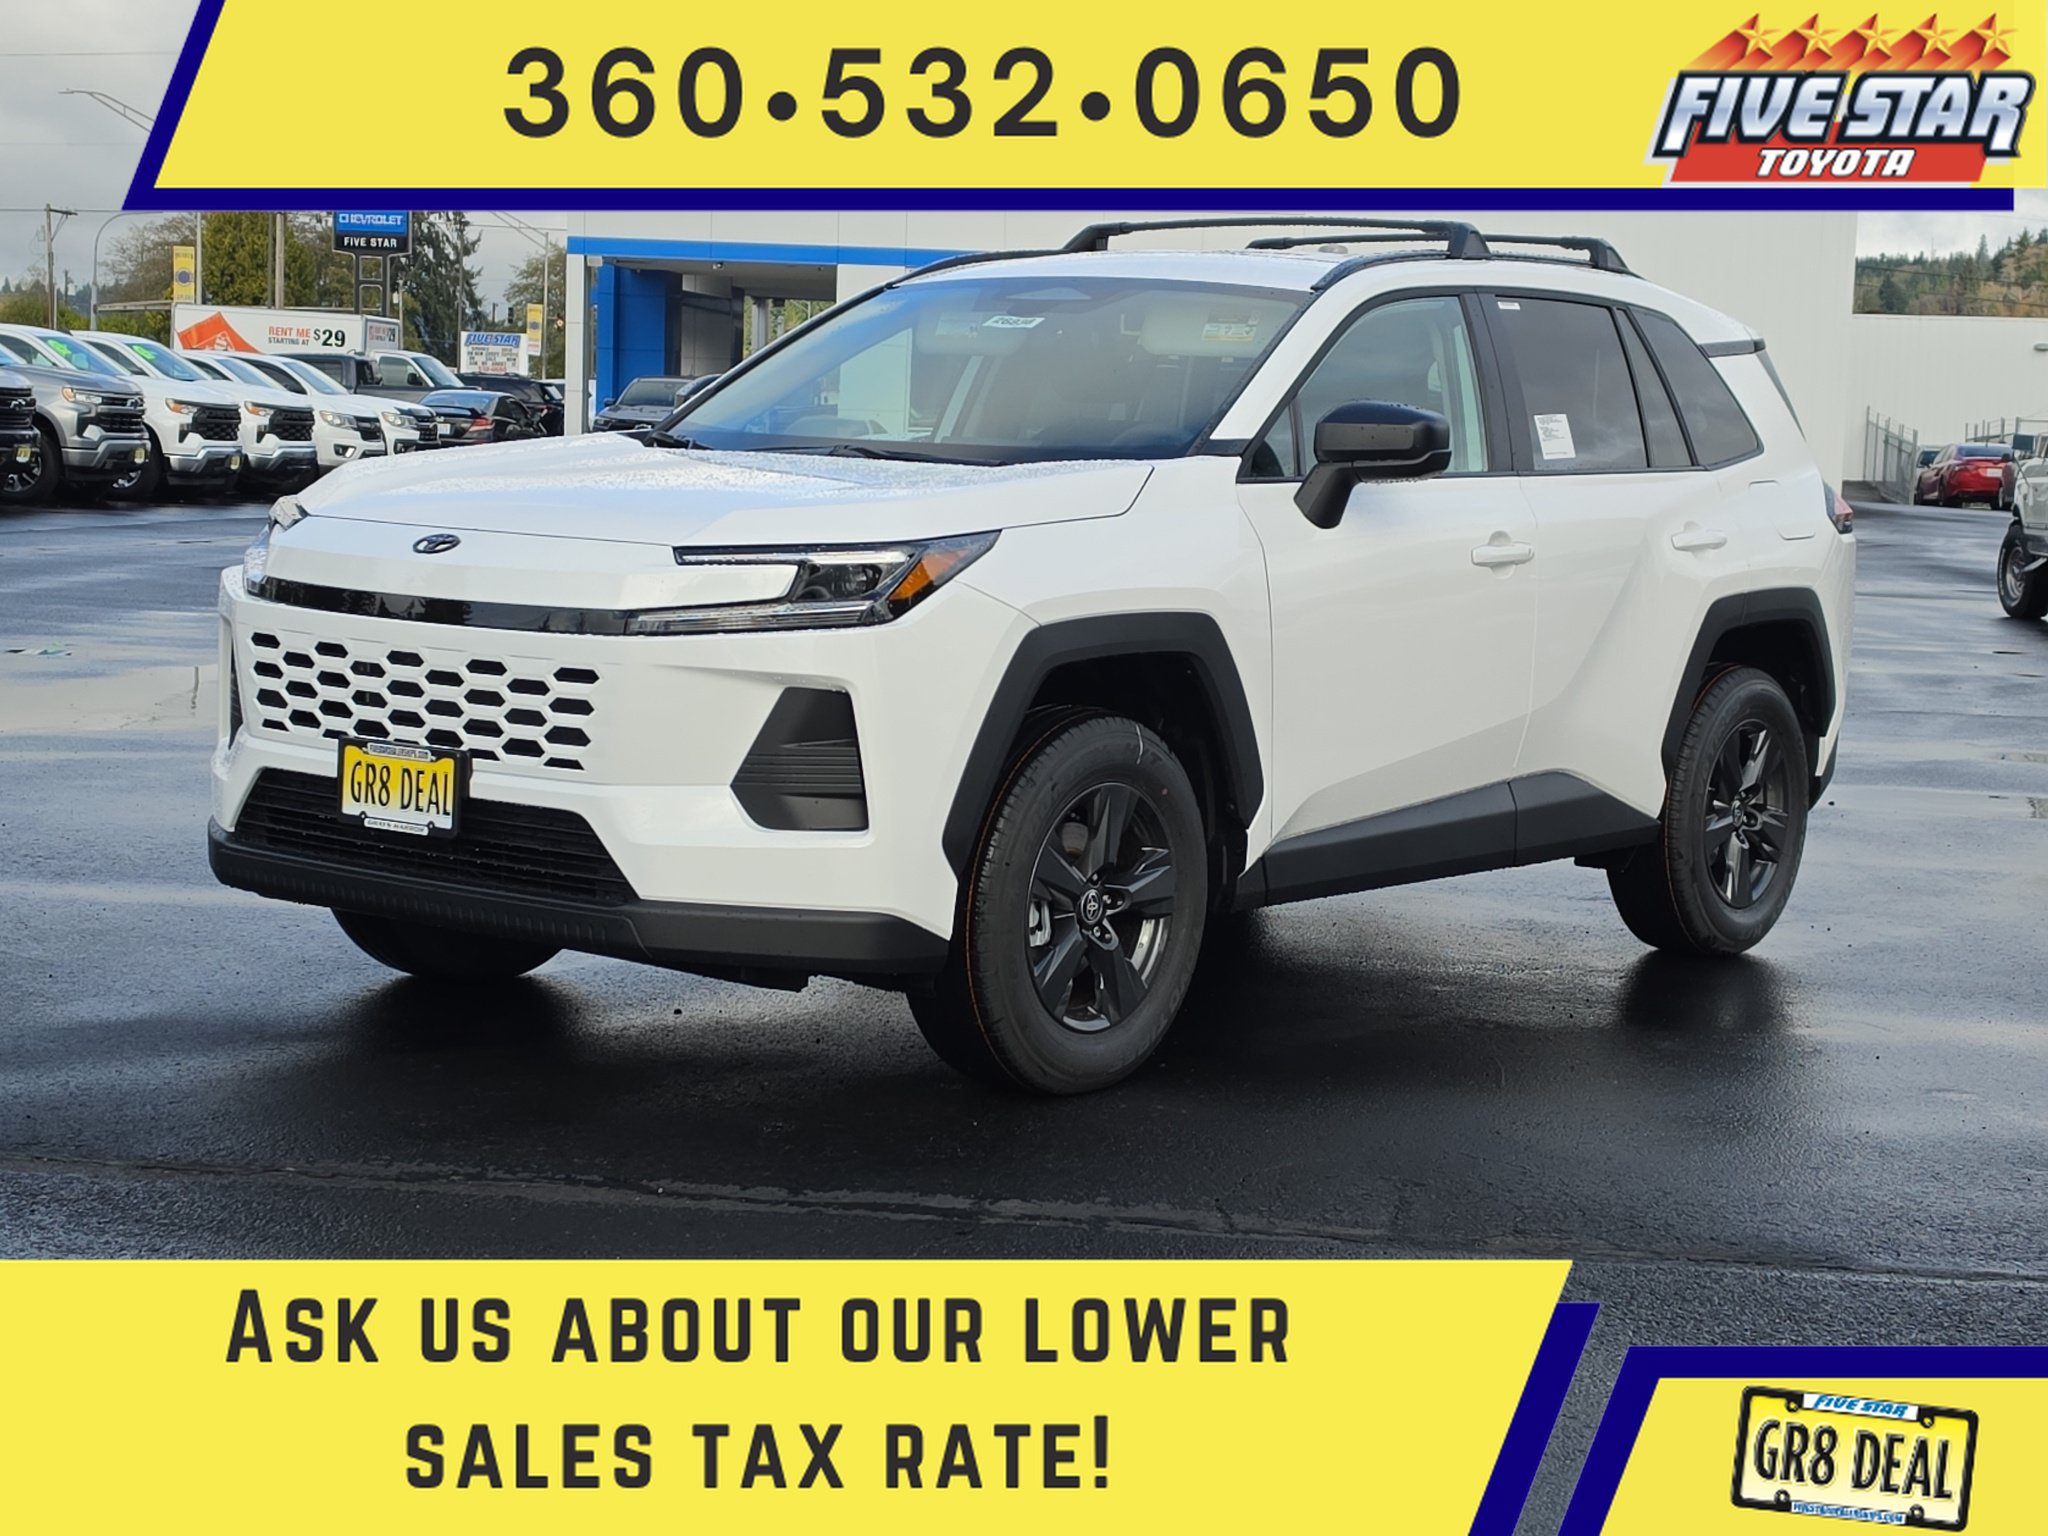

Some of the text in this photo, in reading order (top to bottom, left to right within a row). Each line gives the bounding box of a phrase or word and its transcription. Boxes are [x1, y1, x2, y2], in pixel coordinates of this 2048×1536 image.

[339, 213, 404, 226] CHEVROLET
[343, 236, 398, 248] FIVE STAR
[268, 326, 346, 348] RENT ME $29
[268, 337, 300, 345] STARTING
[464, 333, 493, 347] FIVE
[492, 334, 521, 348] STAR
[350, 760, 451, 816] GR8 DEAL
